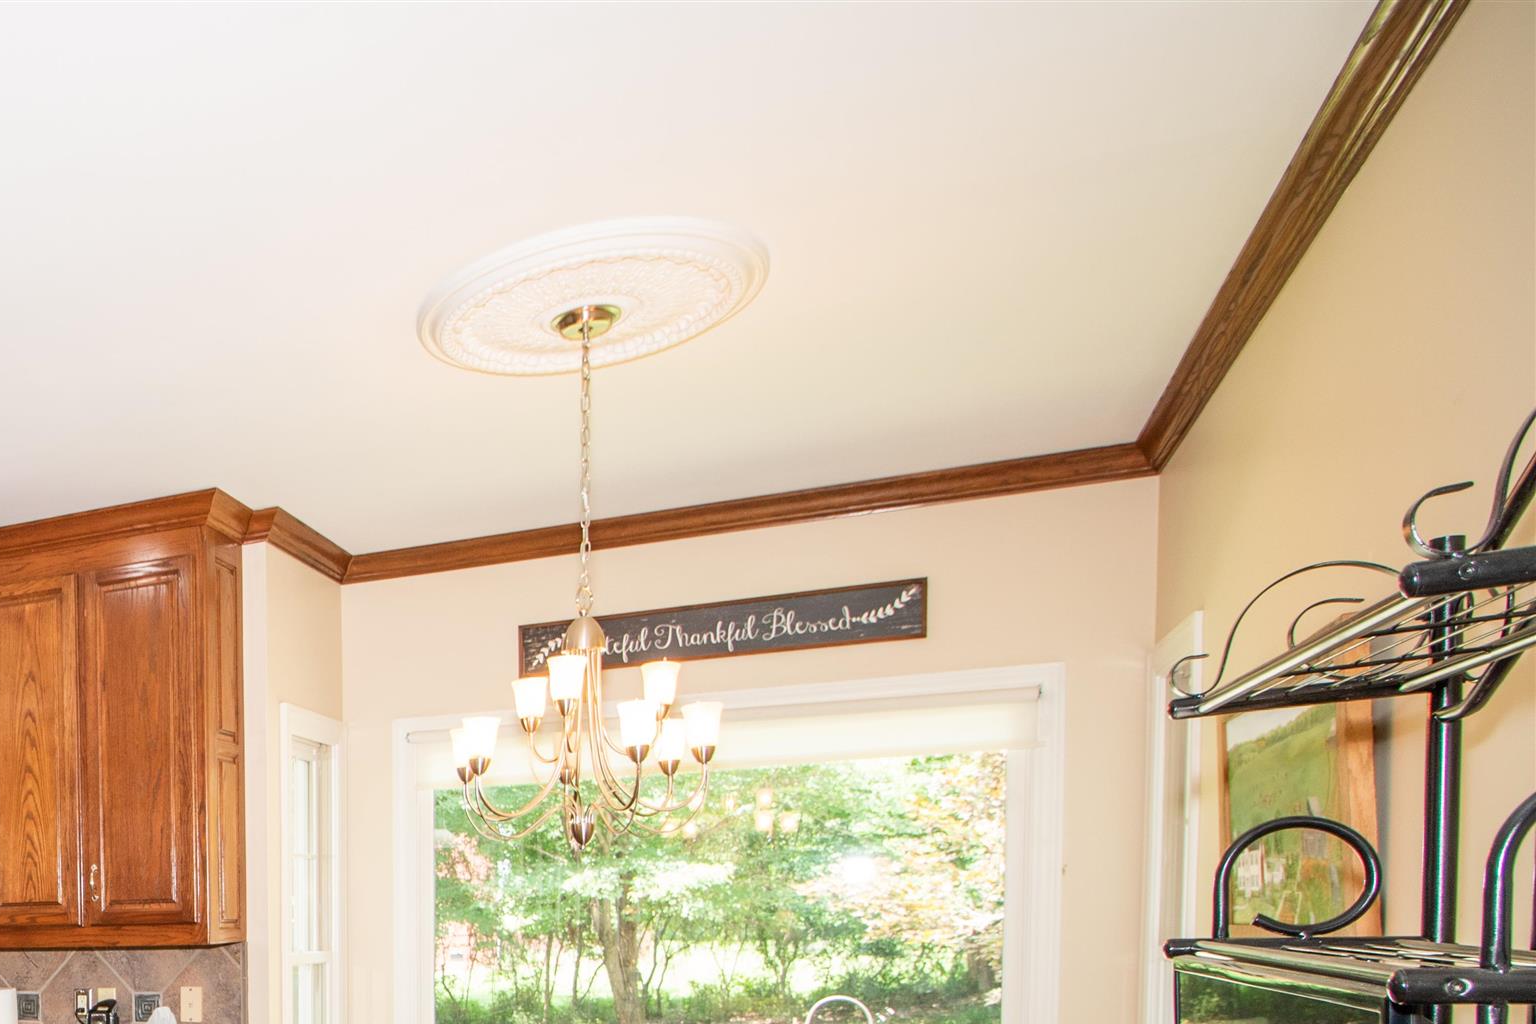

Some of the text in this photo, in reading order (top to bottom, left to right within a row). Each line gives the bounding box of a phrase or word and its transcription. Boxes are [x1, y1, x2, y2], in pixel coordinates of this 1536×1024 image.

[603, 605, 852, 663] teful Thankful Blessed
